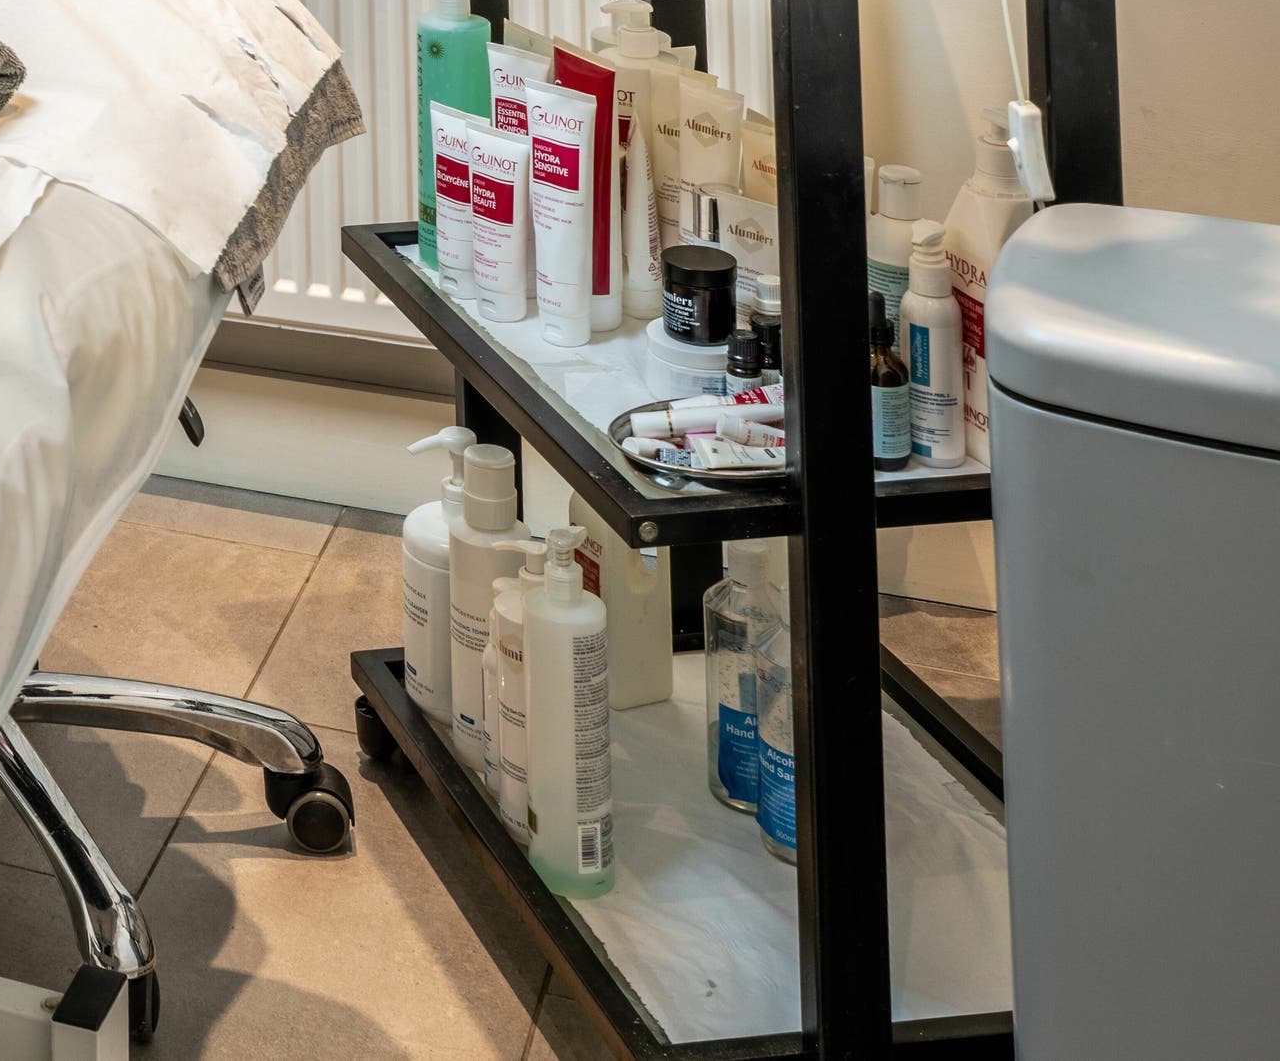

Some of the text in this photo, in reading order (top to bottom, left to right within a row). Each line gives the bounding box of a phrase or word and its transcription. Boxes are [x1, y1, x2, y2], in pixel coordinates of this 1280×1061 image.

[493, 68, 525, 87] GUIN
[497, 106, 527, 120] ESSENTIEL
[497, 115, 518, 126] NUTRI
[531, 105, 584, 132] GUINOT
[497, 123, 528, 136] CONFORT
[436, 128, 467, 151] GUIN
[471, 146, 518, 173] GUINOT
[534, 149, 561, 165] HYDRA
[534, 160, 569, 177] SENSITIVE
[437, 170, 469, 188] BIOXYGÈNE
[474, 184, 496, 199] HYDRA
[474, 195, 497, 210] BEAUTÉ
[945, 250, 987, 286] HYDRA
[964, 402, 989, 428] INOT
[584, 536, 602, 555] INOT
[726, 723, 755, 739] Hand
[767, 748, 795, 769] Alcoh
